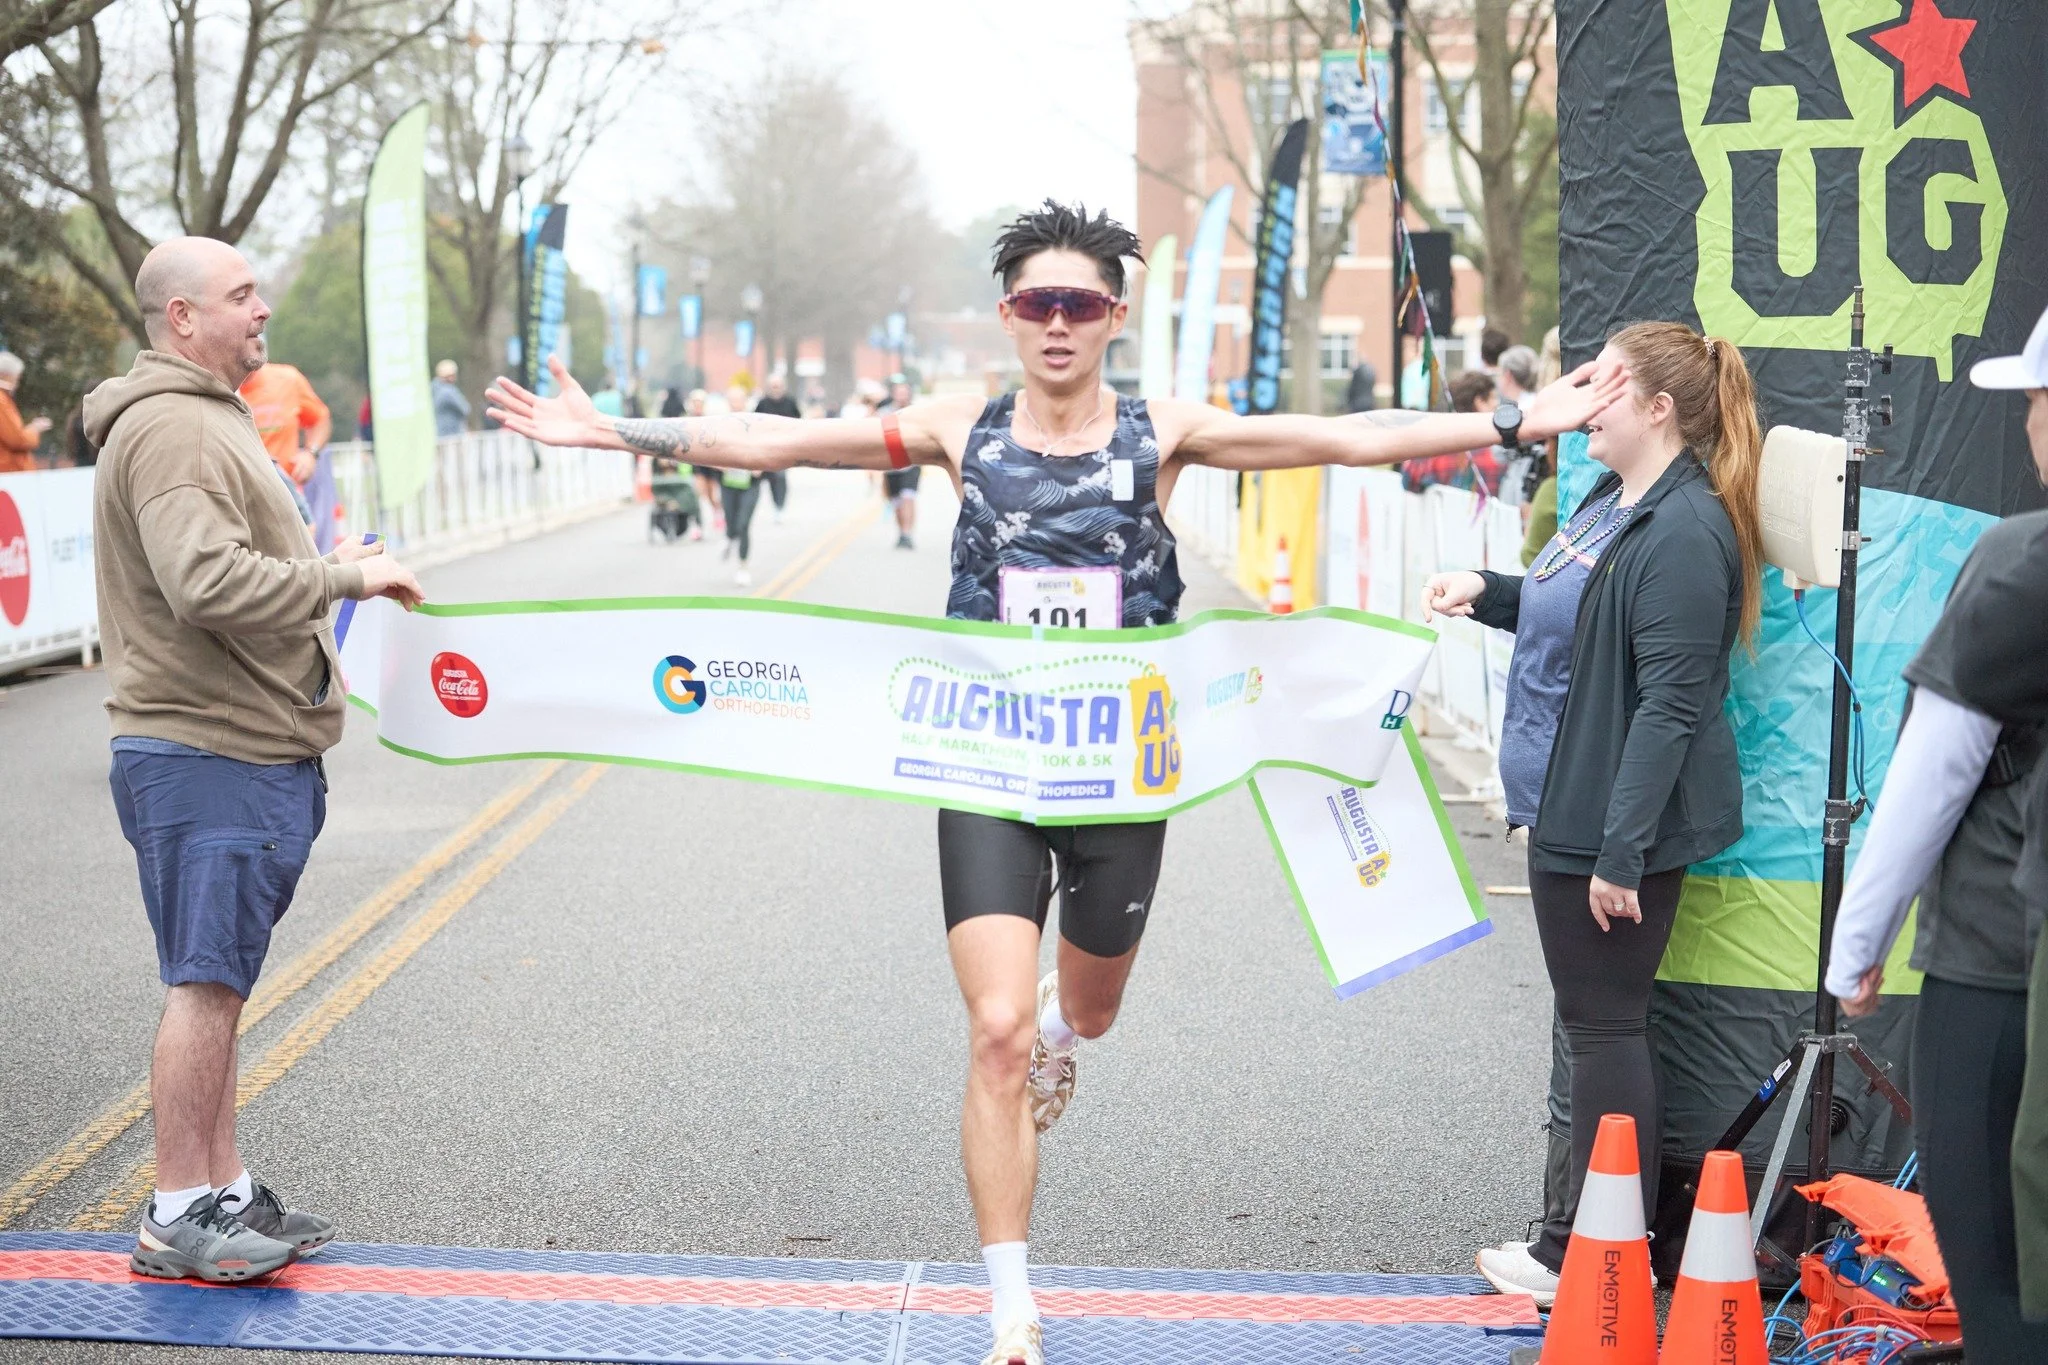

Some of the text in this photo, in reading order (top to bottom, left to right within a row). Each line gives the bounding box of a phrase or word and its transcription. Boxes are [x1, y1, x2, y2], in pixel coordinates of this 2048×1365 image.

[1726, 137, 1986, 318] UG
[707, 660, 803, 683] GEORGIA
[710, 680, 809, 704] CAROLINA
[713, 698, 812, 721] ORTHOPEDICS
[901, 674, 1121, 748] AUGUSTA
[1139, 690, 1167, 737] A
[1042, 754, 1071, 767] 10K
[1076, 754, 1087, 767] &
[1092, 754, 1113, 767] 5K
[899, 762, 942, 778] GEORGIA
[943, 767, 1003, 789] CAROLINA
[1341, 787, 1379, 856] AUGUSTA
